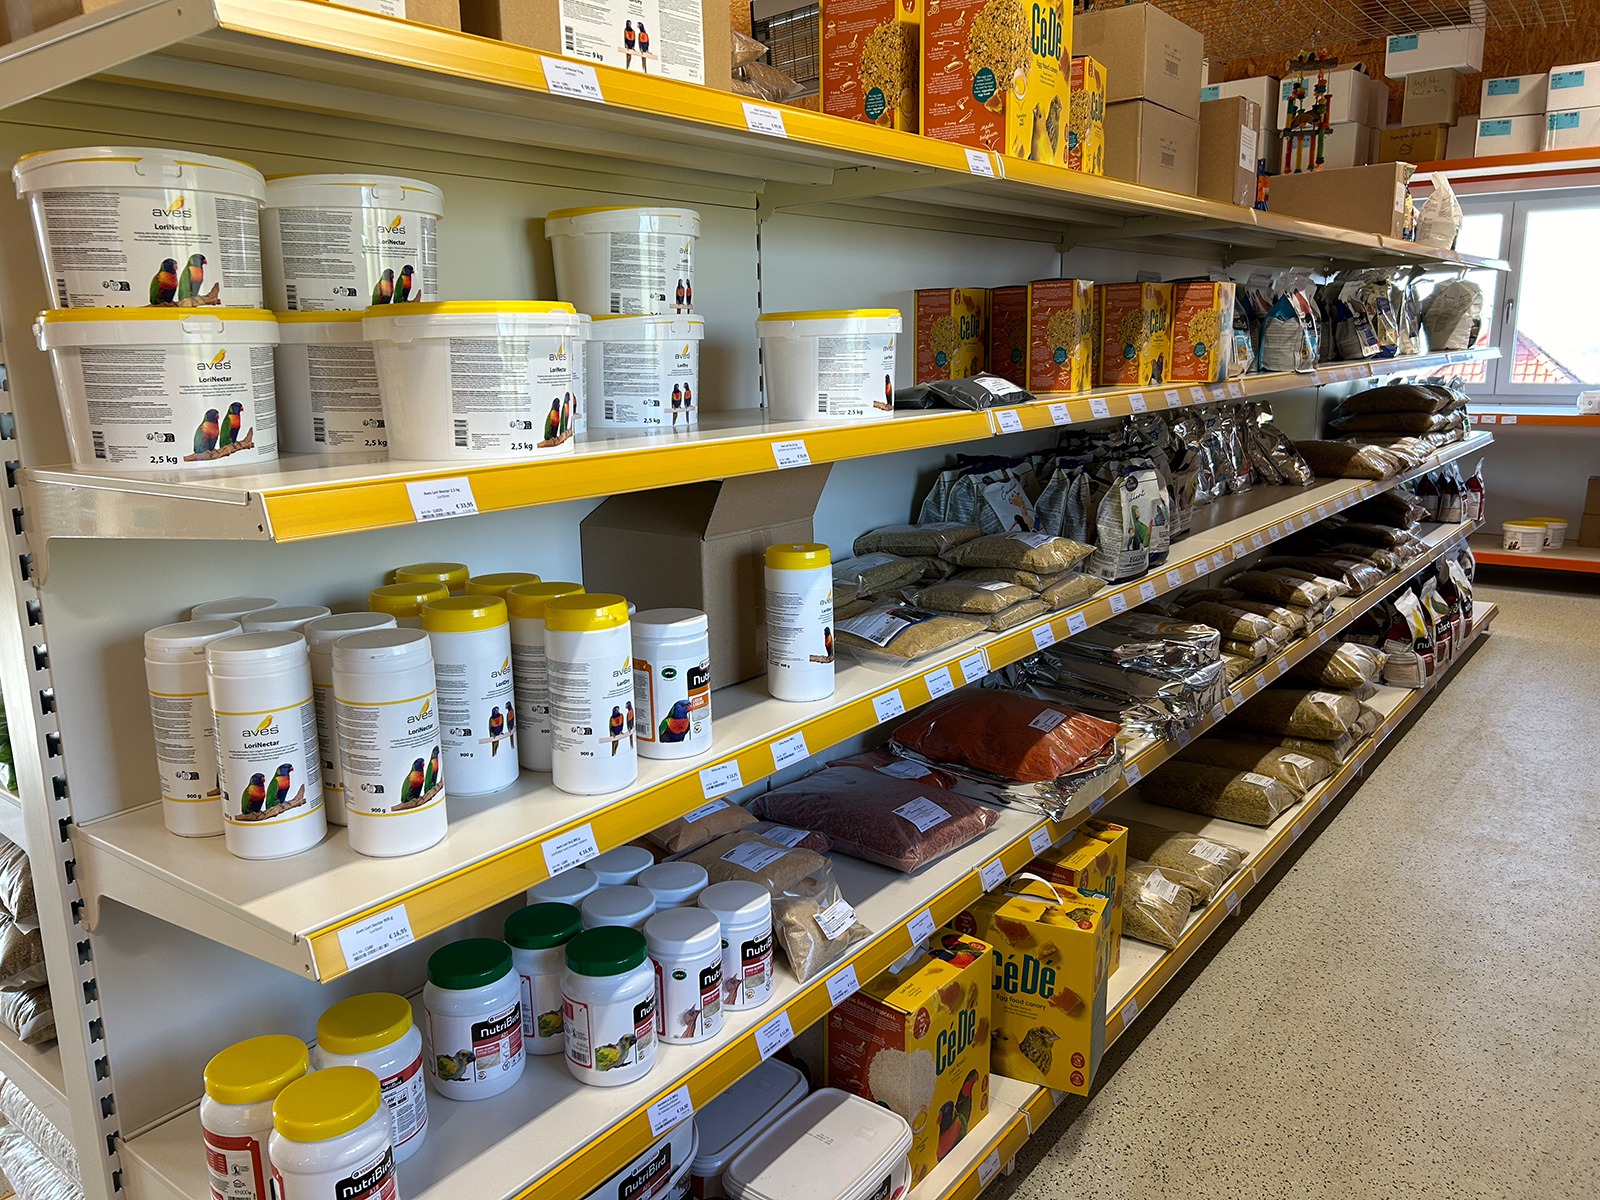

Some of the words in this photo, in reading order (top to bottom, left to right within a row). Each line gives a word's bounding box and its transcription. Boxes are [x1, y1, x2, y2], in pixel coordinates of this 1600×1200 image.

[1031, 2, 1062, 61] CéDé
[152, 207, 192, 218] aves
[154, 223, 192, 231] LoriNectar
[377, 226, 406, 235] aves
[960, 313, 980, 341] CéDé
[549, 352, 567, 361] aves
[197, 361, 231, 371] aves
[198, 375, 232, 384] LoriNectar
[364, 439, 377, 447] 2,5
[378, 439, 388, 447] kg
[511, 442, 523, 451] 2,5
[524, 442, 533, 451] kg
[150, 455, 164, 465] 2,5
[166, 455, 178, 465] kg
[490, 665, 511, 679] aves
[612, 665, 632, 678] aves
[406, 709, 433, 724] aves
[242, 728, 280, 738] aves
[408, 723, 434, 736] LoriNectar
[244, 739, 280, 749] LoriNectar
[996, 993, 1008, 1002] Egg
[1009, 996, 1024, 1005] food
[1025, 1001, 1046, 1011] canary
[480, 1010, 520, 1038] NutriBird
[935, 1000, 976, 1077] CéDé
[342, 1156, 392, 1198] NutriBird
[624, 1154, 667, 1197] NutriBird
